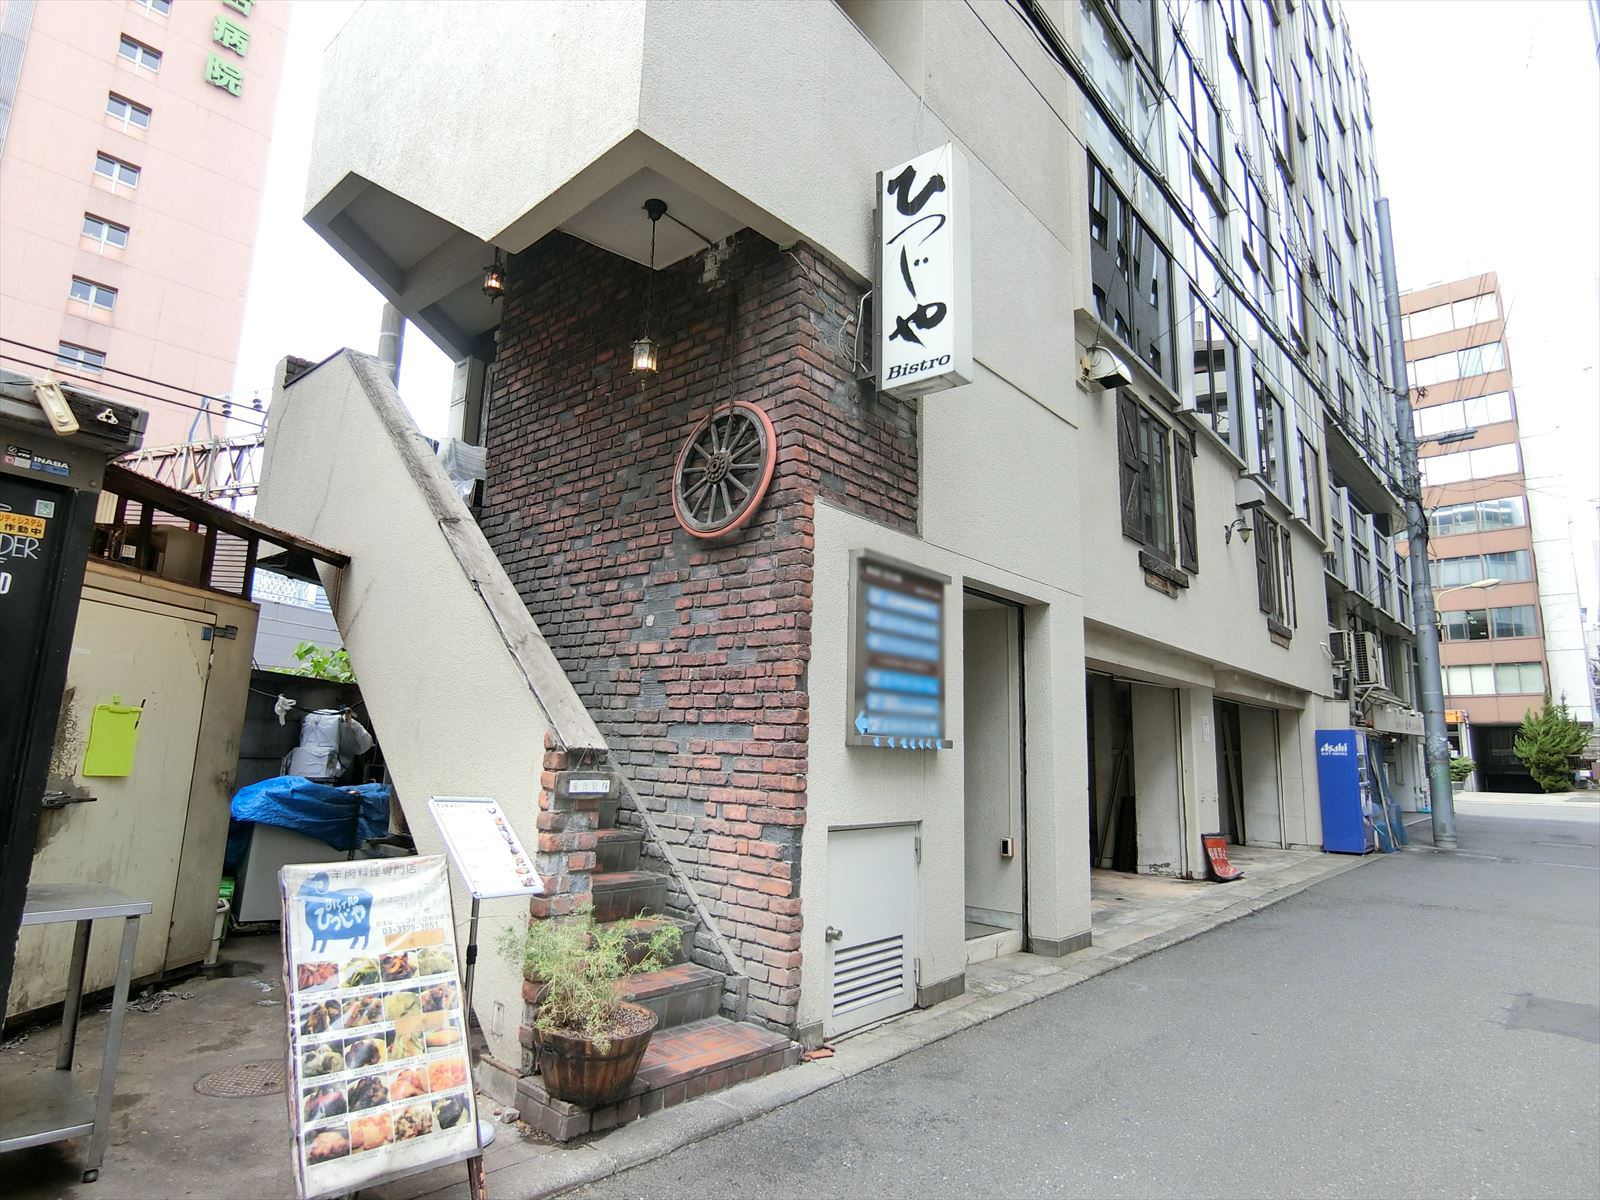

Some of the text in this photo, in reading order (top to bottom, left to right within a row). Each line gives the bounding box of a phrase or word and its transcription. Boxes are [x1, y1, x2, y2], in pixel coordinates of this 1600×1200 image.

[886, 164, 947, 348] ひつじや
[886, 353, 951, 381] Bistro
[34, 456, 69, 469] INABA
[314, 904, 366, 931] ひつじや
[325, 896, 360, 913] BISTRO
